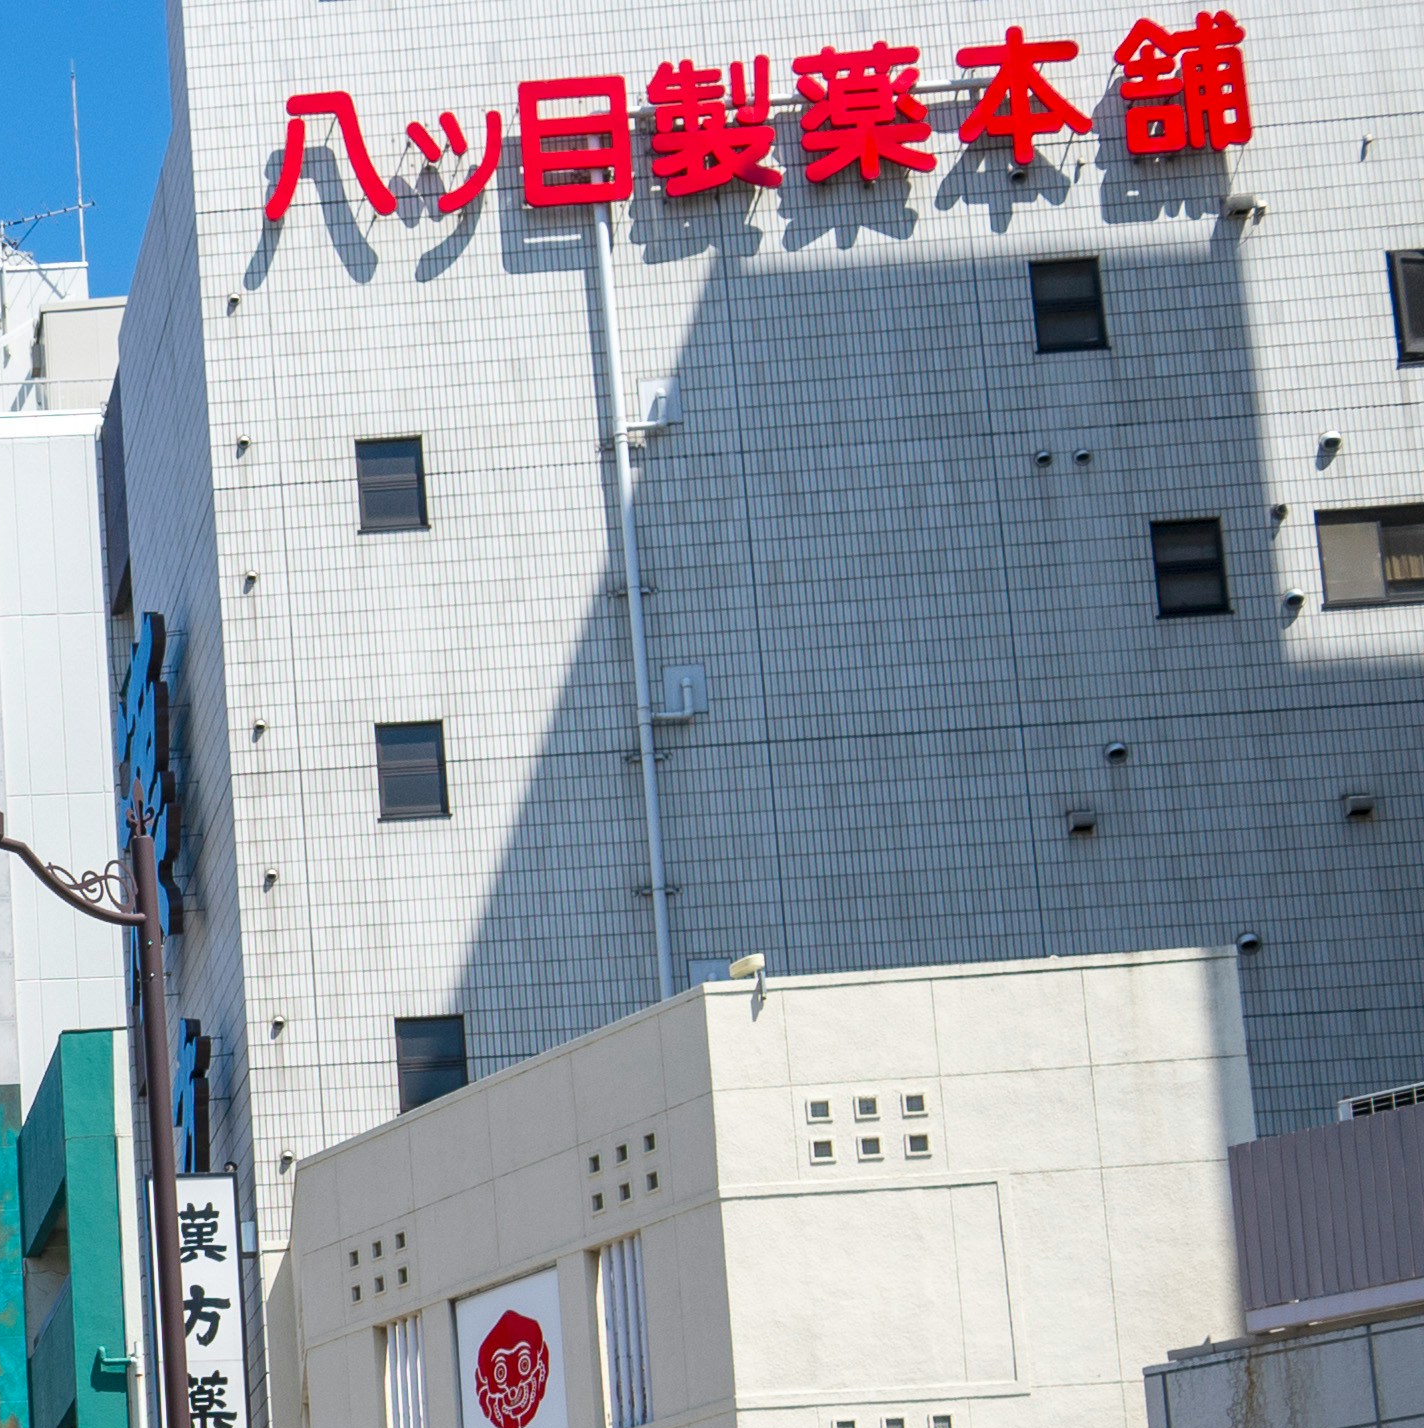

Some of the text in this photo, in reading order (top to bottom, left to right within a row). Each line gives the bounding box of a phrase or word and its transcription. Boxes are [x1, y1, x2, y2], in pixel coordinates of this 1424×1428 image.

[264, 10, 1252, 222] 八ツ目製薬本舗
